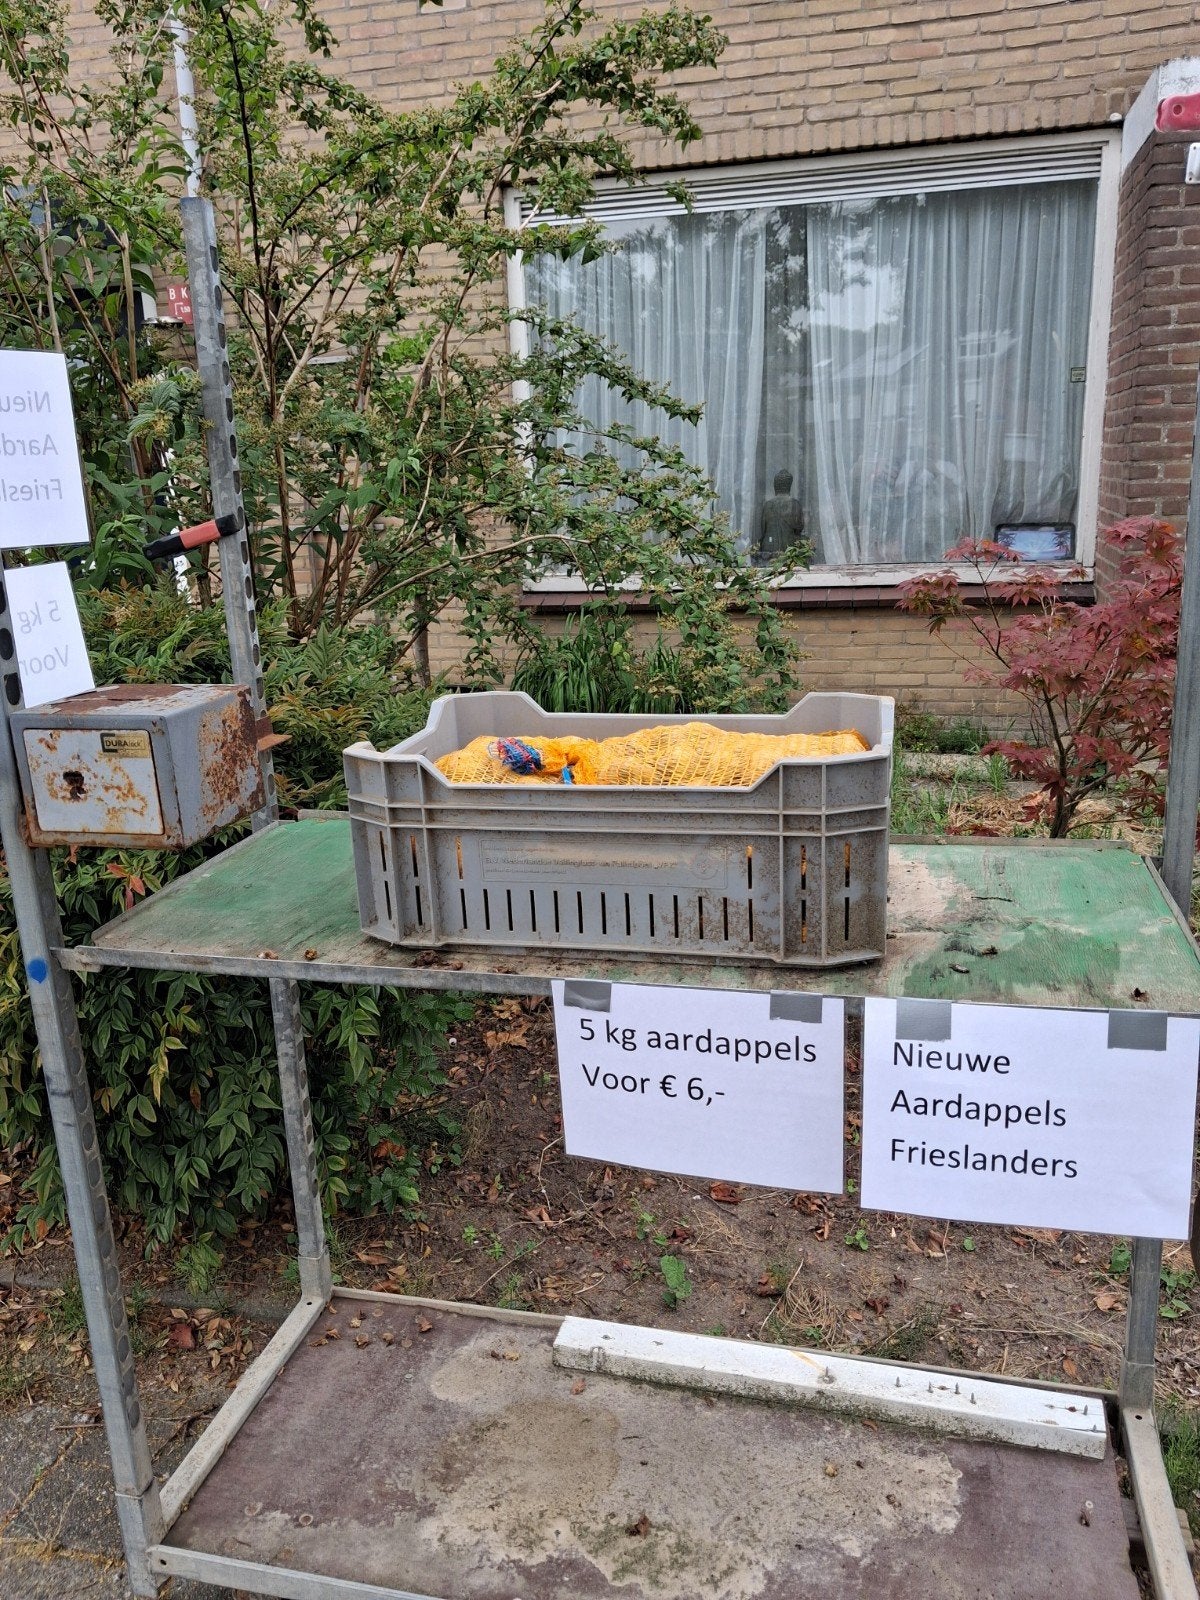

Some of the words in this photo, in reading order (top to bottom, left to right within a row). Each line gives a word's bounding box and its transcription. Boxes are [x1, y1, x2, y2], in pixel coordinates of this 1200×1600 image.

[580, 1018, 595, 1041] 5
[605, 1018, 637, 1052] kg
[646, 1028, 818, 1065] aardappels
[892, 1041, 1012, 1075] Nieuwe
[581, 1063, 651, 1094] Voor
[659, 1074, 678, 1098] €
[686, 1077, 726, 1107] 6,-
[890, 1089, 1068, 1129] Aardappels
[890, 1138, 1079, 1179] Frieslanders
